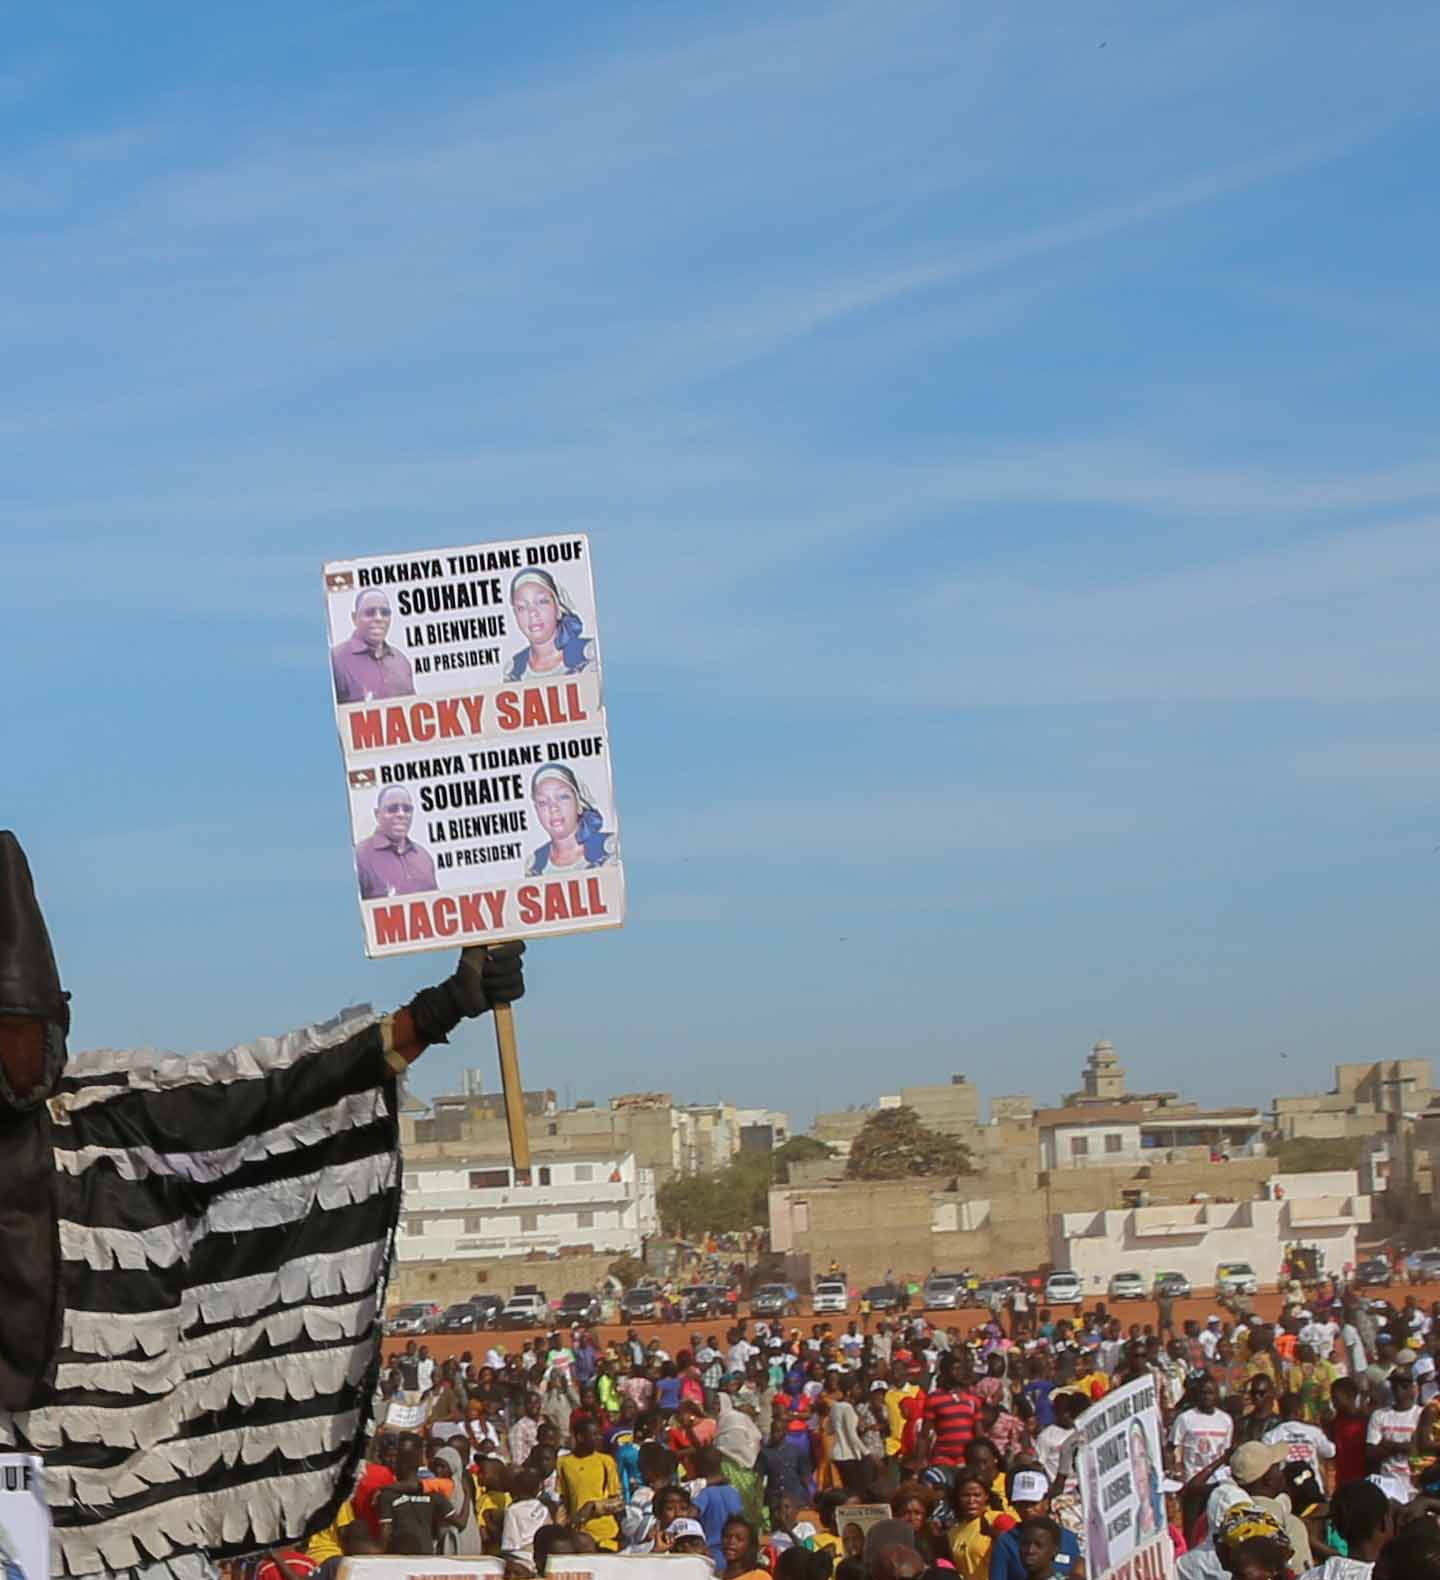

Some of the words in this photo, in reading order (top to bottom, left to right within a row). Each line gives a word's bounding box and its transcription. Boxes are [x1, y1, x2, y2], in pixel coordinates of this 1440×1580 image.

[358, 559, 443, 586] ROKHAYA
[447, 549, 521, 575] TIDIANE
[526, 541, 583, 565] DIOUF
[398, 579, 503, 616] SOUHAITE
[406, 625, 424, 647] LA
[427, 615, 507, 645] BIENVENUE
[415, 656, 430, 673] AU
[434, 648, 501, 670] PRESIDENT
[349, 696, 485, 751] MACKY
[497, 684, 587, 730] SALL
[381, 755, 466, 783] ROKHAYA
[469, 745, 542, 771] TIDIANE
[547, 737, 603, 761] DIOUF
[420, 775, 524, 812] SOUHAITE
[428, 821, 447, 843] LA
[450, 811, 528, 840] BIENVENUE
[437, 853, 453, 870] AU
[456, 844, 522, 866] PRESIDENT
[373, 889, 508, 946] MACKY
[519, 878, 607, 924] SALL
